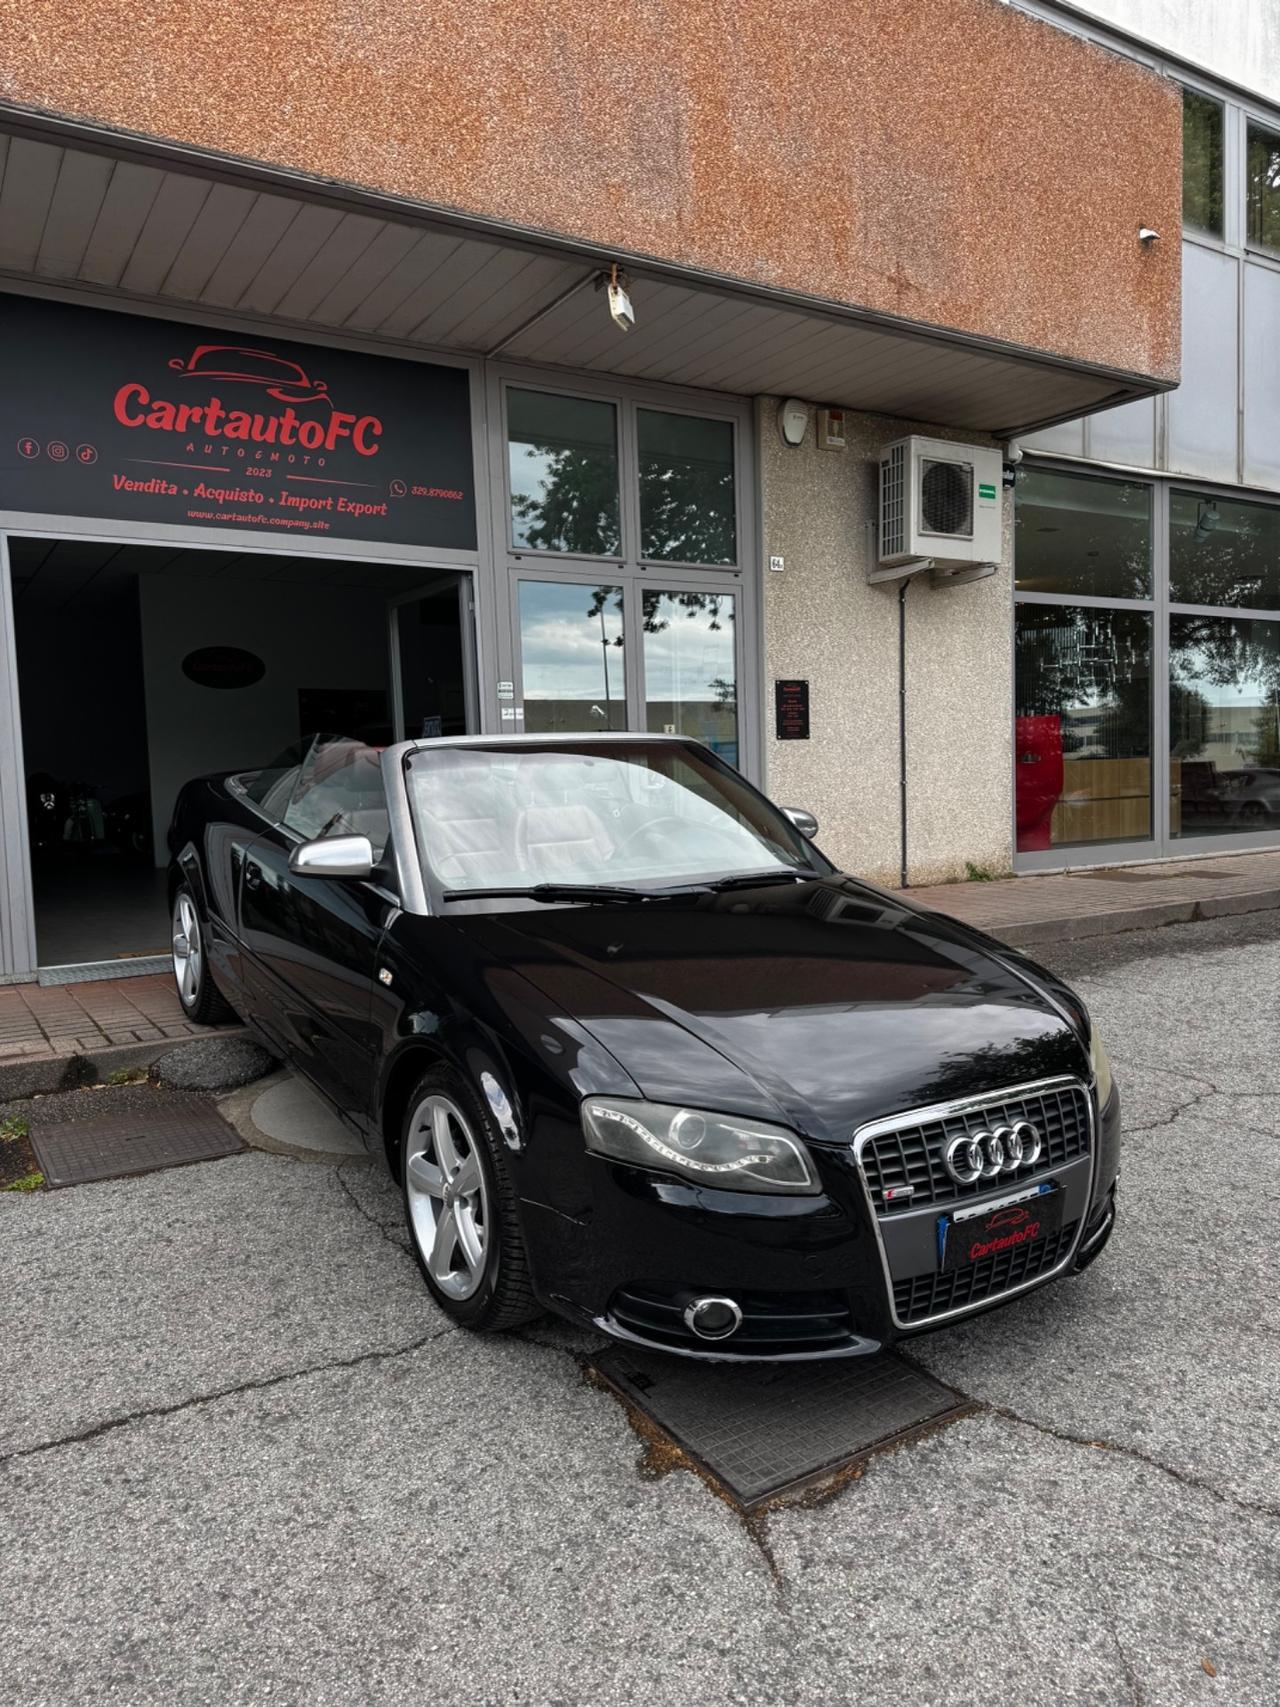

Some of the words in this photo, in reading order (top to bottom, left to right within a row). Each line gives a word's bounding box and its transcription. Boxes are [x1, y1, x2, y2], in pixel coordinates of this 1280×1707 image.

[113, 383, 384, 457] CartautoFC
[245, 467, 273, 478] 2023
[112, 474, 178, 496] Vendita
[193, 483, 264, 504] Acquisto
[279, 491, 333, 512] Import
[336, 497, 388, 517] Export
[187, 510, 331, 530] www.cartautofc.company.site
[970, 1221, 1040, 1261] CartautoFC
